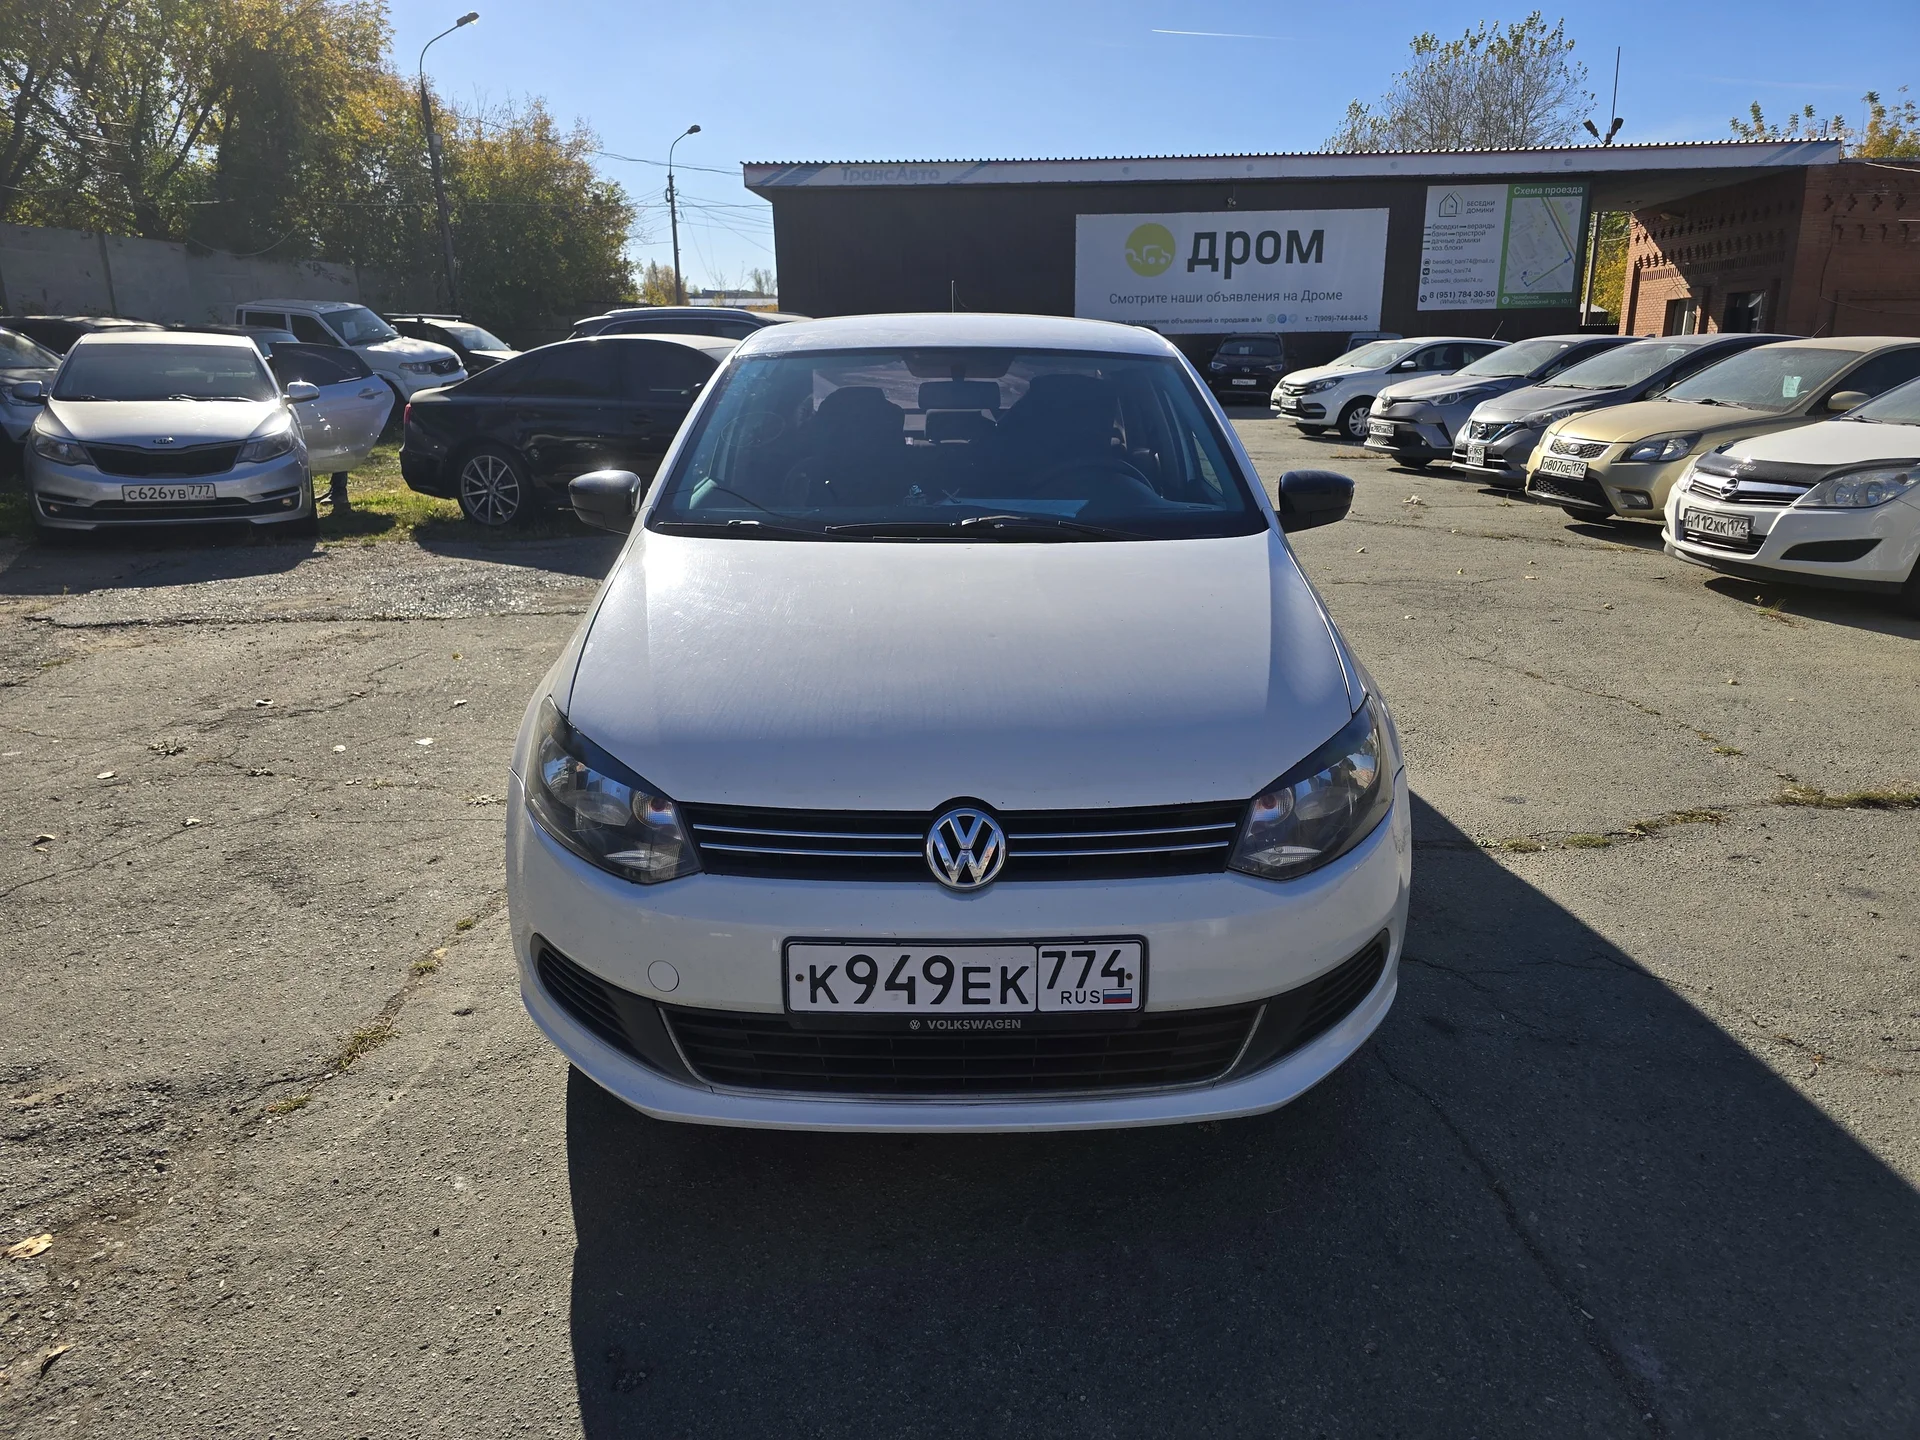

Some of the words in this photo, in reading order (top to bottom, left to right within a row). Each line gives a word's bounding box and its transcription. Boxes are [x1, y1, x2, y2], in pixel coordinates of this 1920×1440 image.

[1513, 186, 1543, 195] Схема
[1545, 186, 1583, 196] проезда
[1431, 223, 1459, 231] беседки
[1455, 230, 1486, 238] пристрой
[1186, 229, 1325, 280] дром
[1109, 293, 1168, 306] Смотрите
[1171, 293, 1203, 303] наши
[1206, 291, 1280, 303] объявления
[1283, 291, 1298, 301] на
[1300, 289, 1343, 303] Дроме
[1429, 291, 1435, 299] 8
[1436, 291, 1456, 299] (951)
[1458, 290, 1472, 298] 784
[1473, 290, 1496, 298] 30-50
[1171, 316, 1213, 325] объявлений
[1220, 316, 1250, 325] продаже
[127, 486, 187, 500] С626УВ
[188, 485, 210, 496] 777
[808, 953, 1031, 1005] К949ЕК
[1041, 949, 1126, 990] 774
[1060, 989, 1101, 1005] RUS
[927, 1019, 1021, 1030] VOLKSWAGEN
